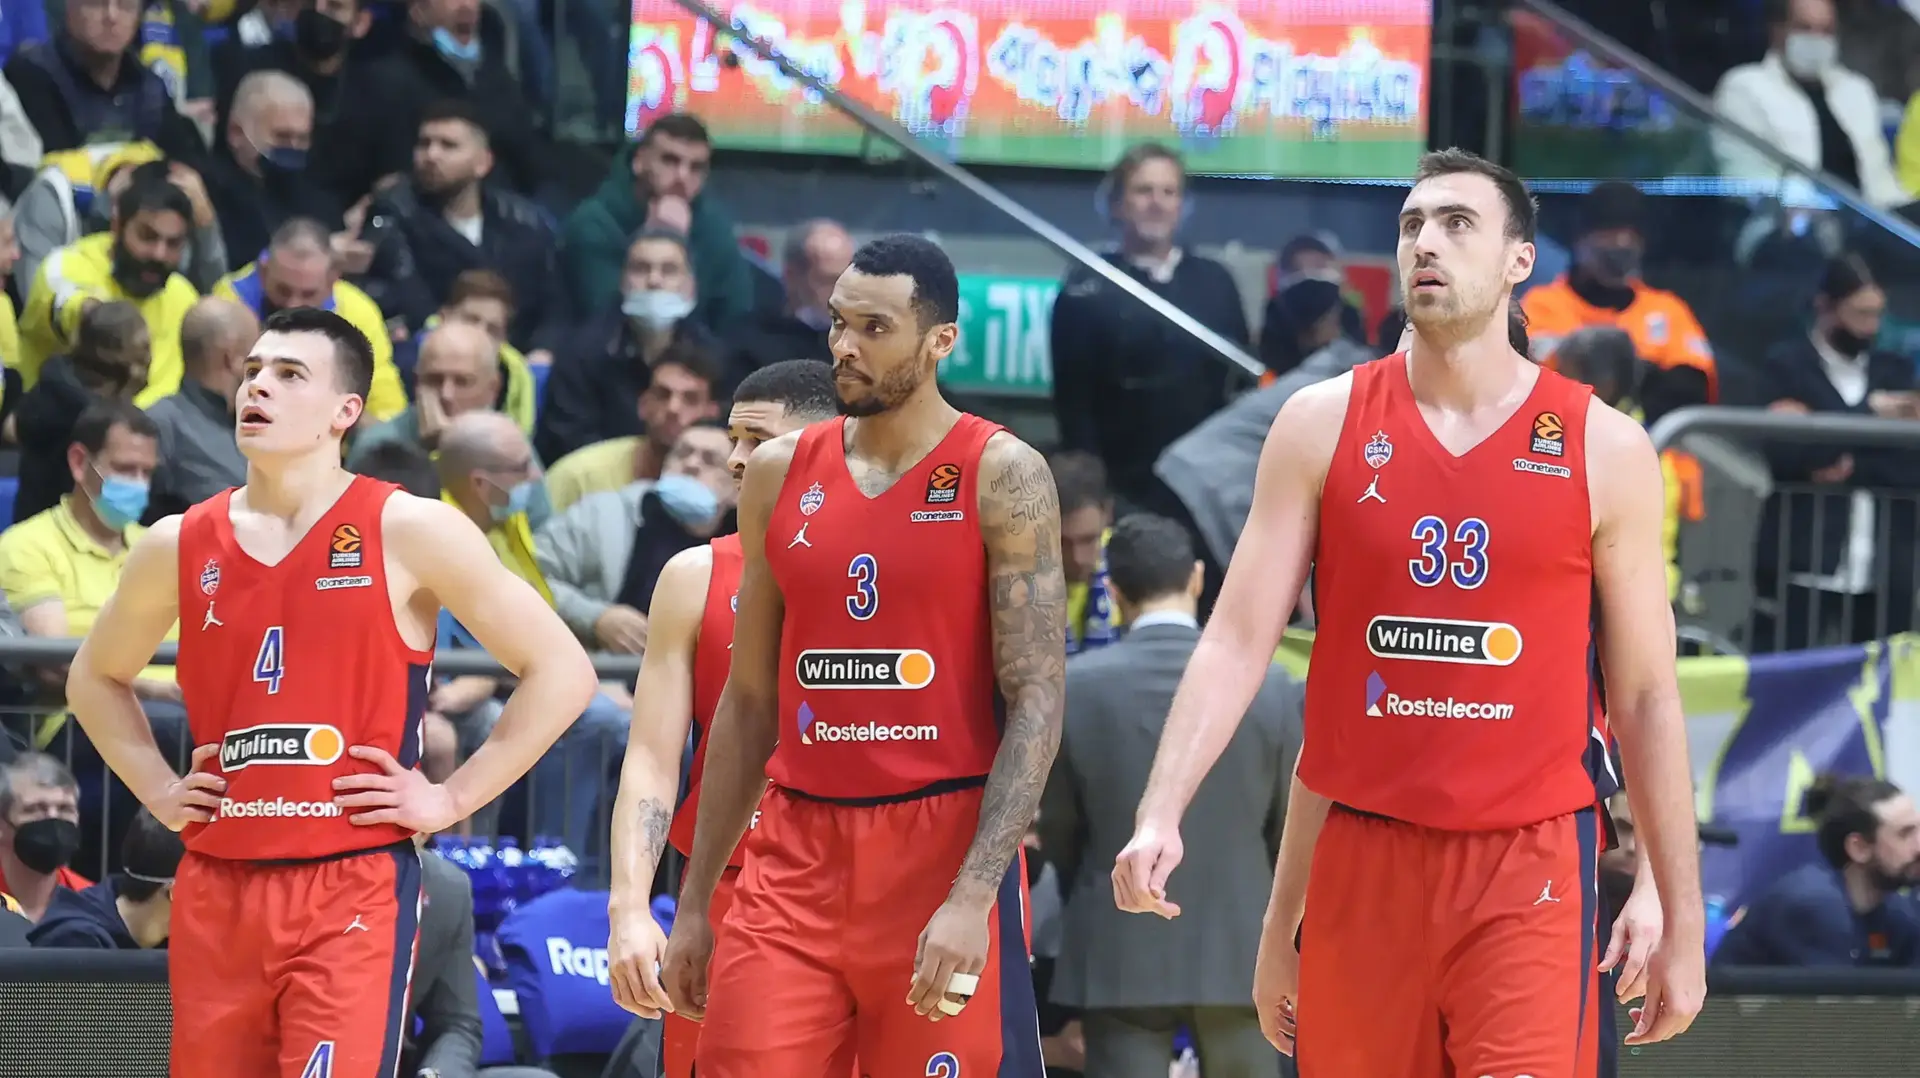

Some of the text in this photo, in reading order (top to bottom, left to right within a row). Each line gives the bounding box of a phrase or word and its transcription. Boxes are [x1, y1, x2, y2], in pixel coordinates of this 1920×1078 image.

[1367, 445, 1389, 454] CSKA
[803, 493, 821, 503] CSKA
[1408, 515, 1490, 590] 33
[846, 553, 879, 621] 3
[1377, 625, 1476, 654] Winline
[252, 626, 285, 695] 4
[804, 658, 890, 681] Winline
[1386, 693, 1515, 720] Rostelecom
[815, 721, 938, 742] Rostelecom
[224, 733, 300, 762] Winline
